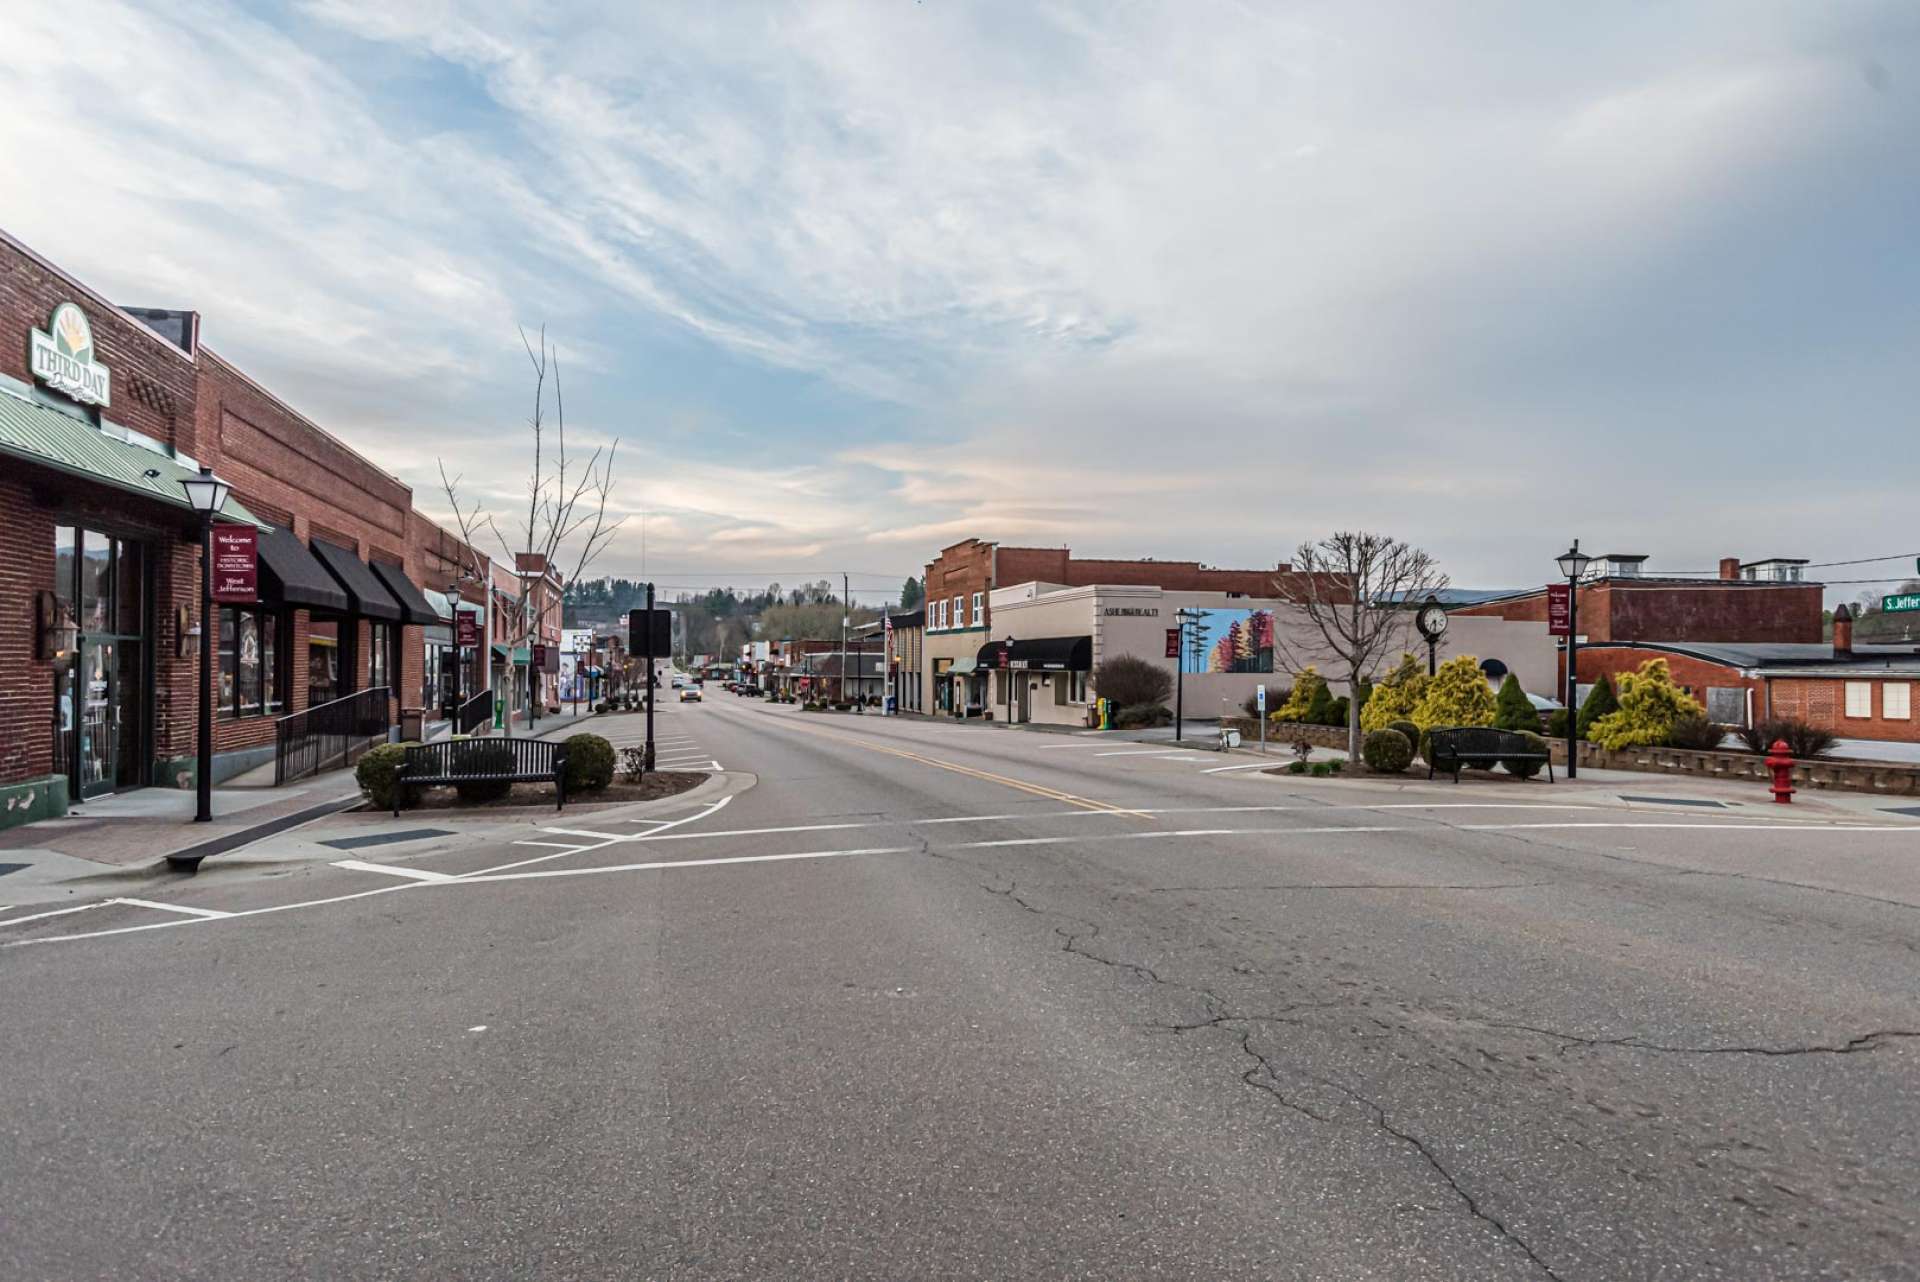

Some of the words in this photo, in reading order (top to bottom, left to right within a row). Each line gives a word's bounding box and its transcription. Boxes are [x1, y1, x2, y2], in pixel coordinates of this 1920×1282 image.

[36, 344, 80, 382] THIRD
[82, 367, 105, 400] DAY
[216, 584, 255, 592] Jefferson
